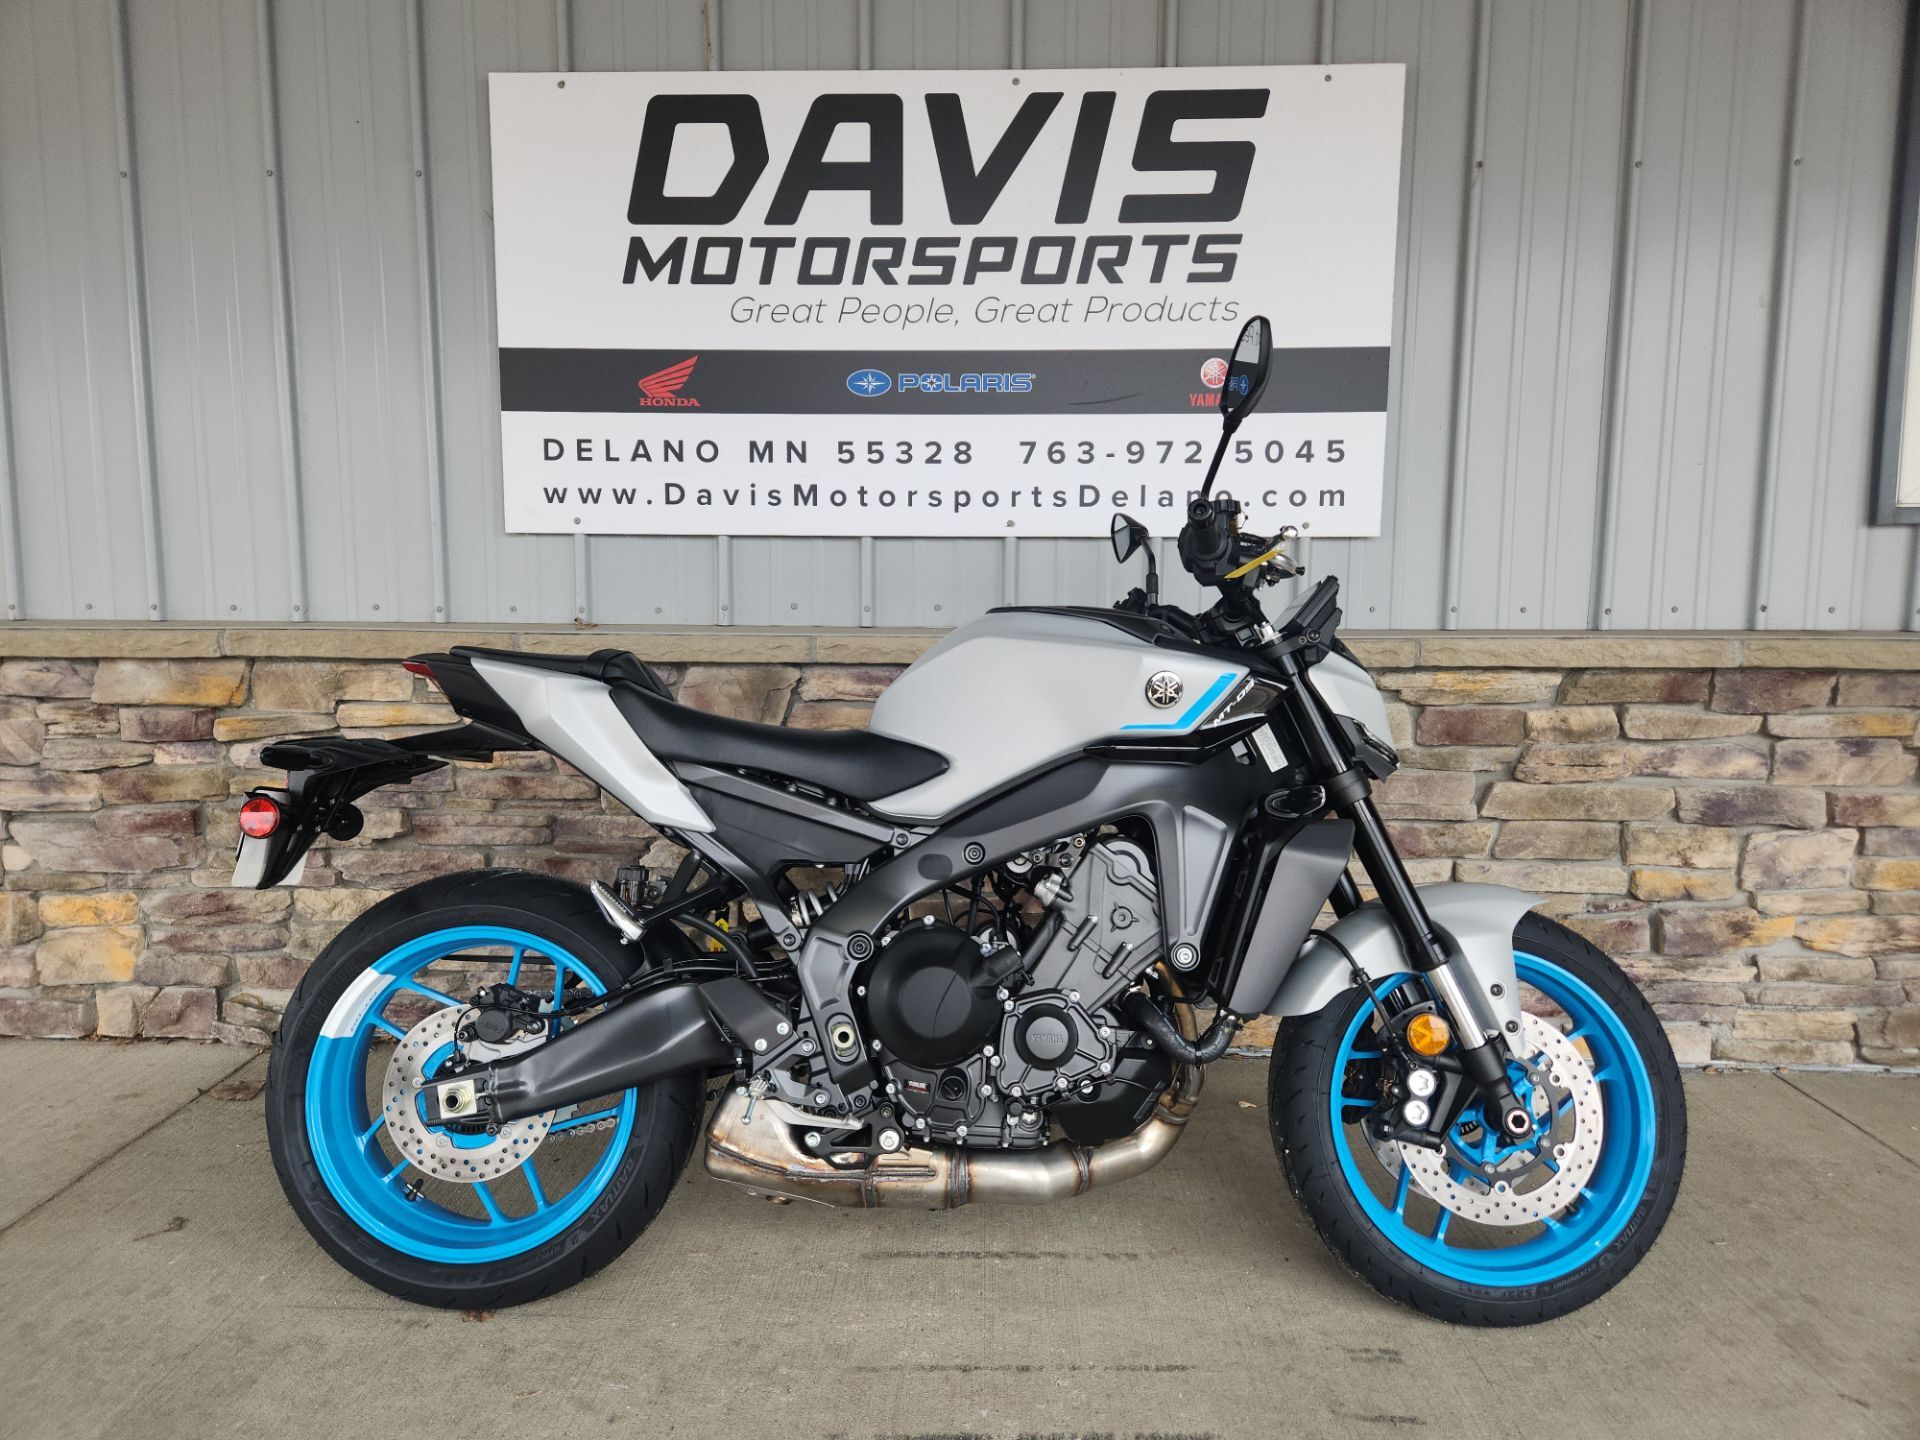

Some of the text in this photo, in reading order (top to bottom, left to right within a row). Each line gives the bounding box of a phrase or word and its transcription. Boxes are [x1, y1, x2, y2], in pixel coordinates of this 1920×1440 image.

[627, 88, 1270, 225] DAVIS
[623, 234, 1243, 285] MOTORSPORTS
[730, 295, 1240, 330] Great People, Great Products
[898, 373, 1033, 392] POLARIS
[639, 397, 700, 407] HONDA
[1189, 393, 1222, 407] YAMA
[543, 438, 1346, 464] DELANO MN 55328 763-9725045
[1213, 678, 1255, 727] MT-09
[1032, 1033, 1063, 1043] YAMAHA
